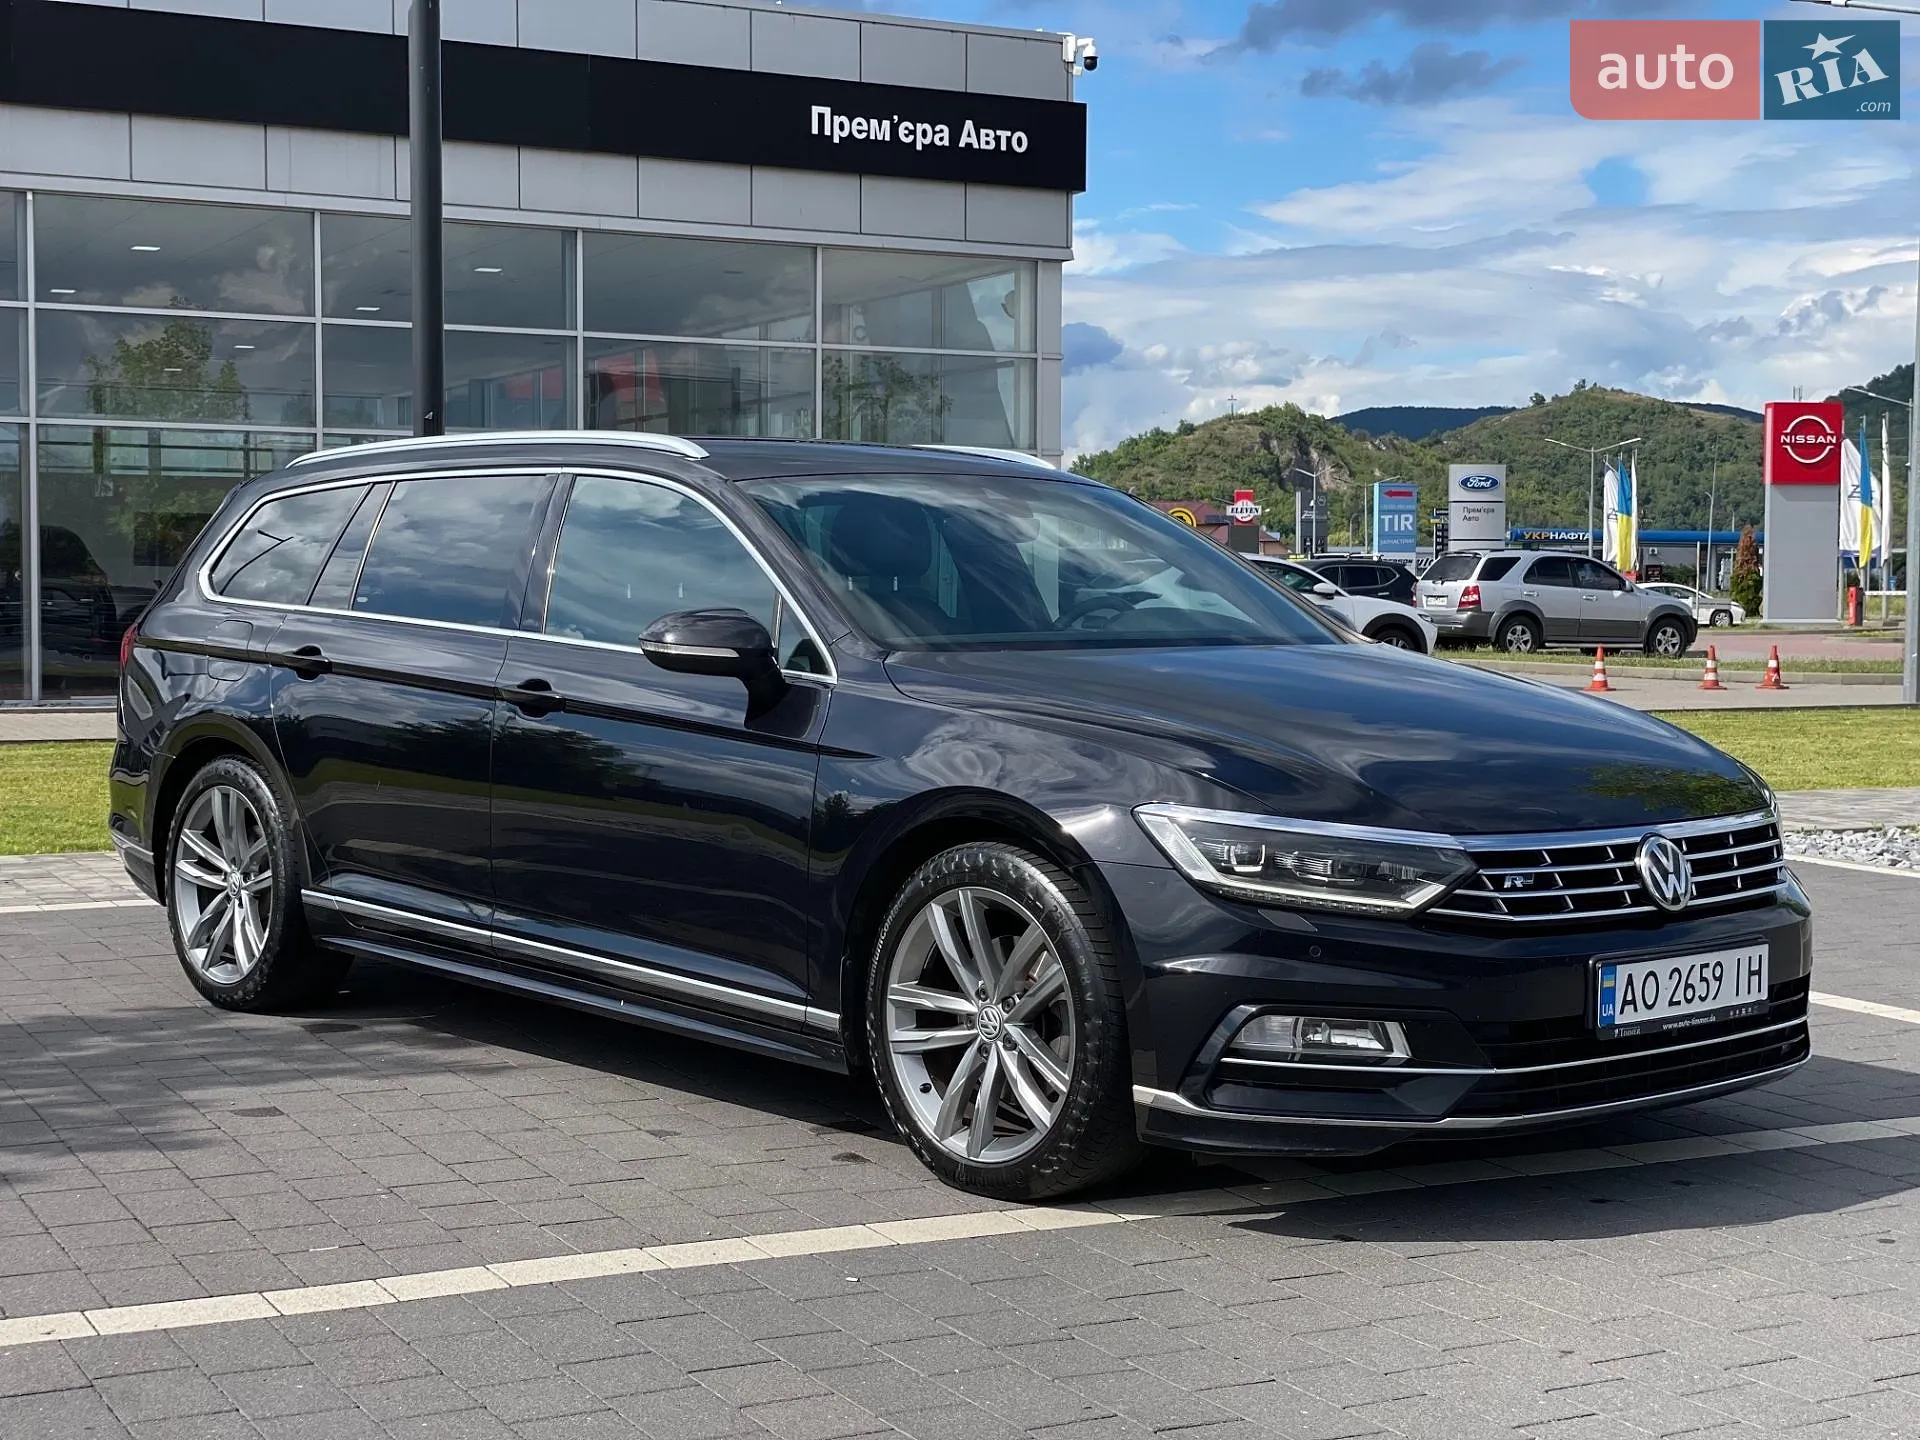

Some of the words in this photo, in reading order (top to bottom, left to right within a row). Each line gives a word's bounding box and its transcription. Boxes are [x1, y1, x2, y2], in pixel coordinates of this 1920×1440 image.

[958, 119, 1028, 153] Авто
[1780, 434, 1837, 444] NISSAN
[1466, 476, 1493, 488] Ford
[1380, 513, 1414, 532] TIR
[1462, 514, 1480, 522] Авто
[1523, 531, 1591, 541] УКРНАФТА
[1619, 970, 1660, 1015] AO
[1668, 960, 1724, 1007] 2659
[1735, 954, 1763, 997] IH
[1602, 1003, 1614, 1017] UA
